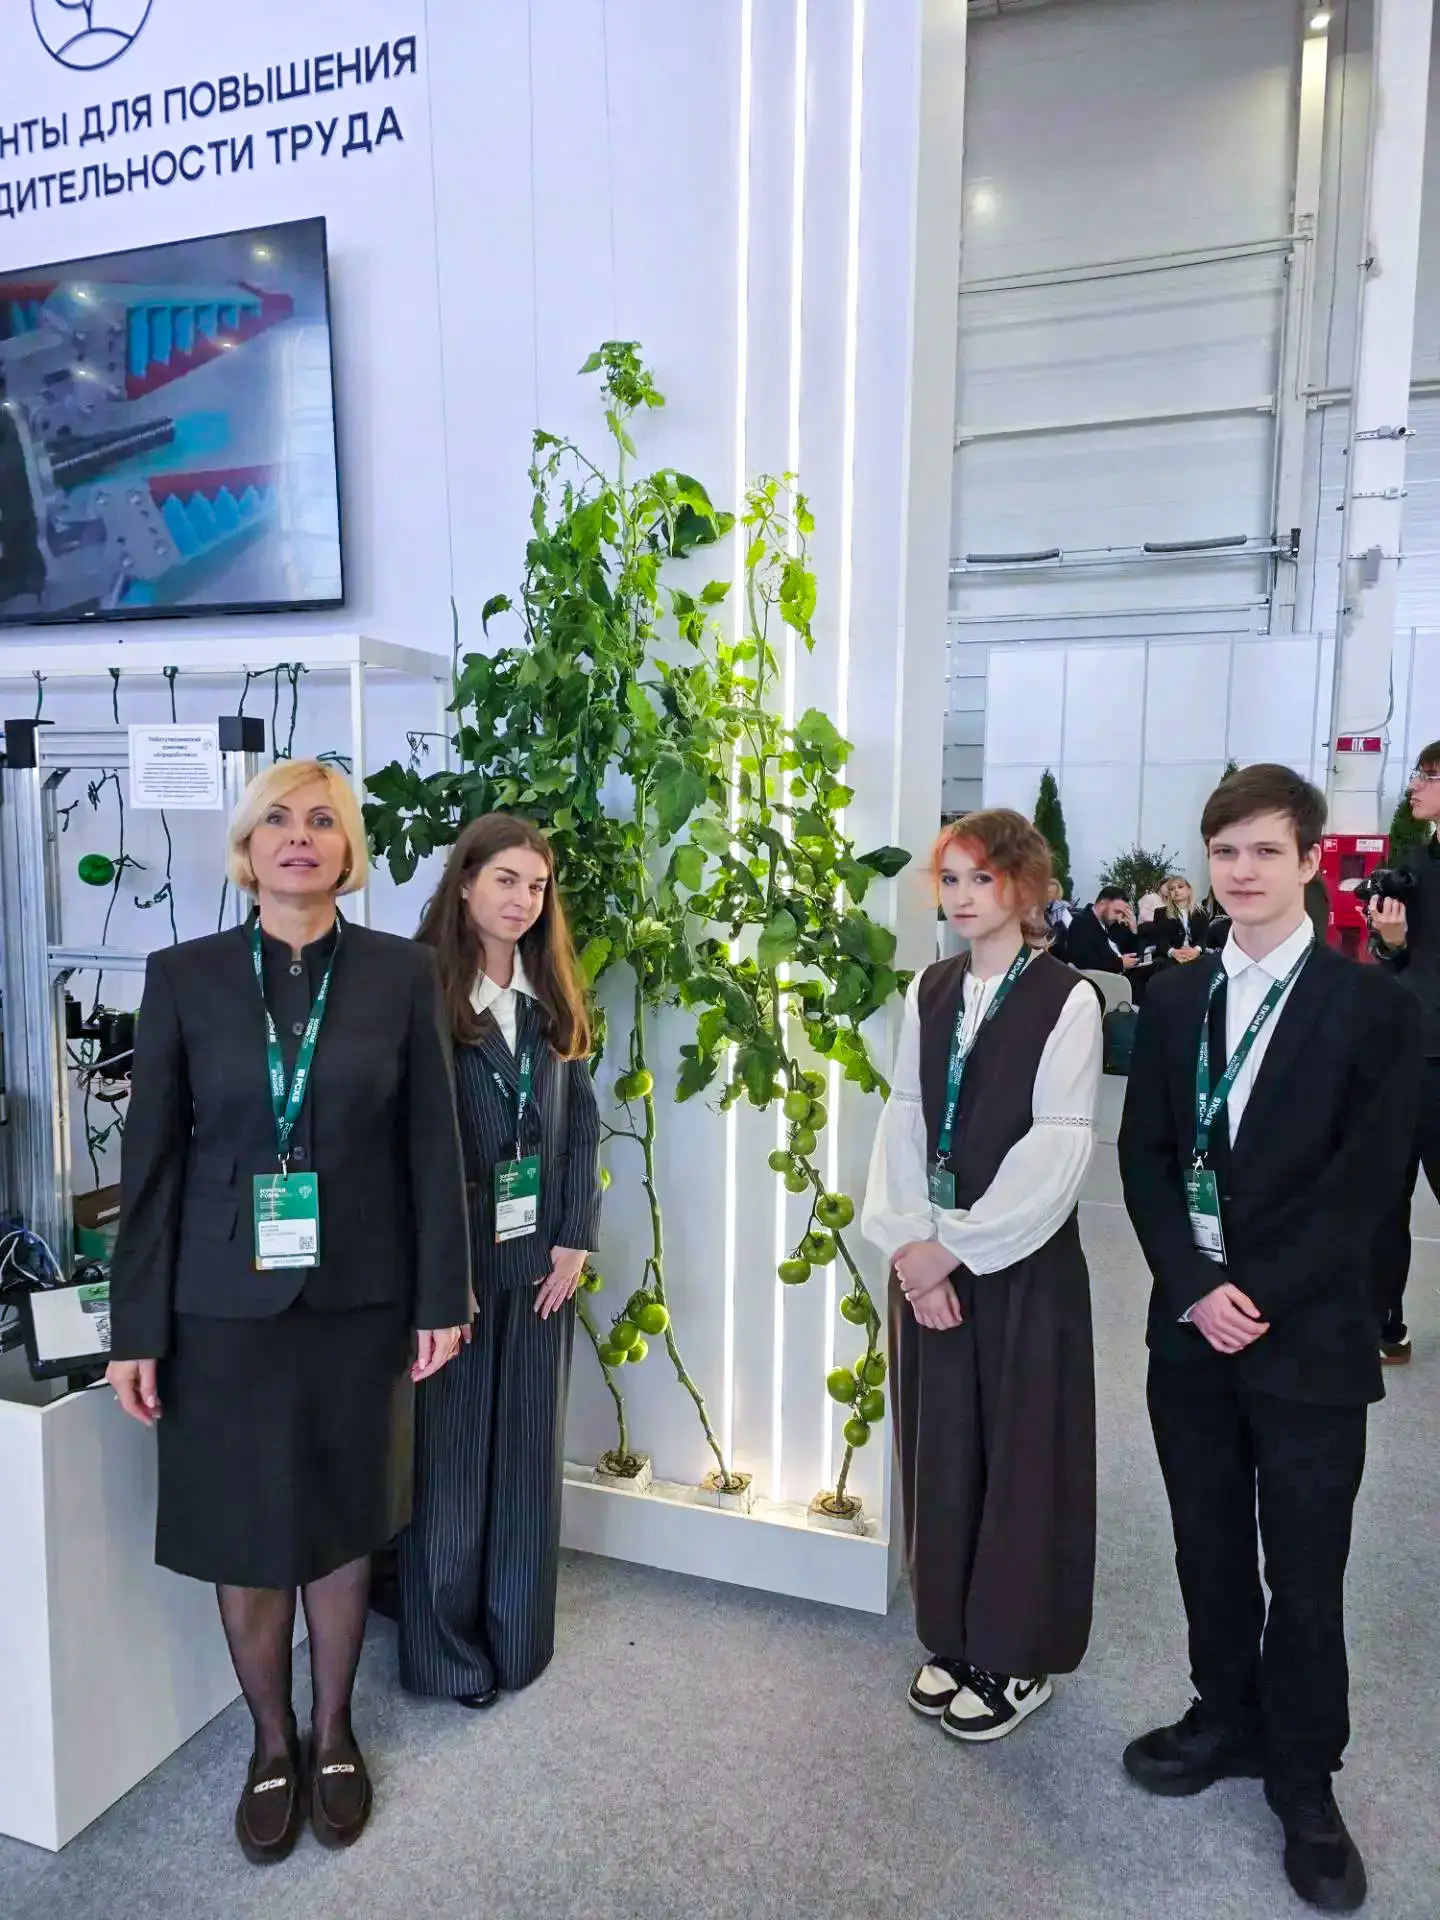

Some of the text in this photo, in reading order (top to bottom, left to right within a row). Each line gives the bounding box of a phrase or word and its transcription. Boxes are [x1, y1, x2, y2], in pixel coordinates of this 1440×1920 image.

[79, 93, 153, 147] ДЛЯ
[164, 34, 418, 126] ПОВЫШЕНИЯ
[266, 105, 404, 166] ТРУДА
[1351, 738, 1365, 751] ПК
[1254, 1004, 1270, 1026] РСХБ
[292, 1077, 304, 1103] РСХБ
[1206, 1097, 1221, 1119] РСХБ
